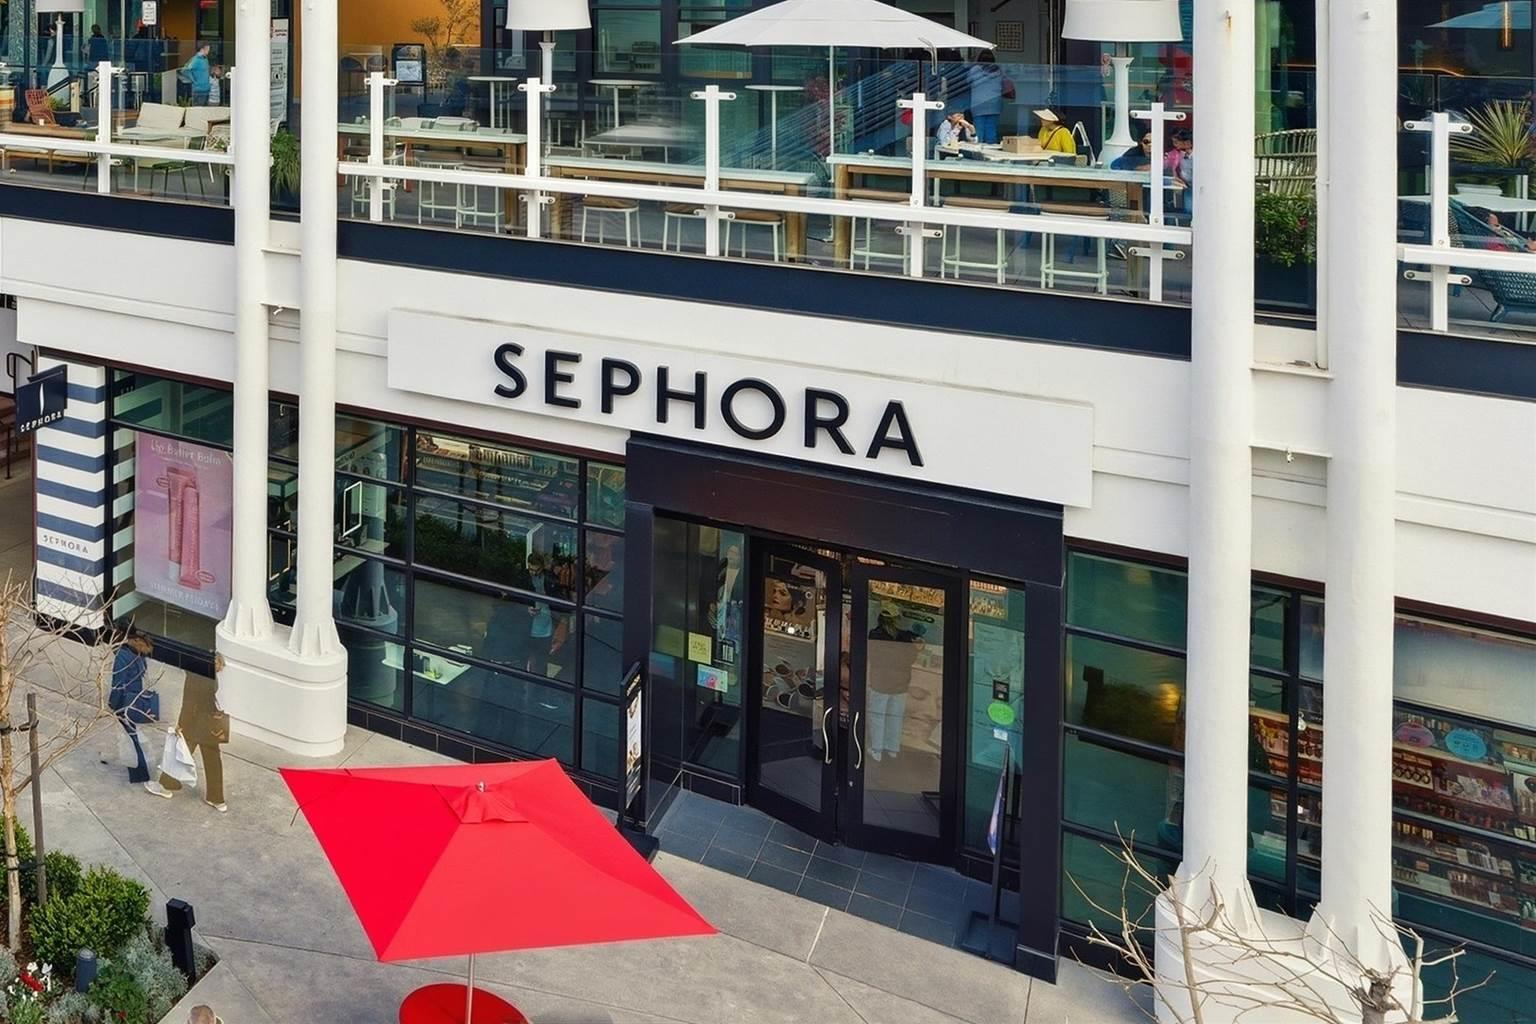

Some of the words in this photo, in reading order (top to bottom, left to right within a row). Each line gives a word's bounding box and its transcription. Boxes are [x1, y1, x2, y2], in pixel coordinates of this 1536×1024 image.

[493, 342, 925, 468] SEPHORA
[20, 410, 64, 433] SEPHORA
[43, 534, 88, 554] SEPHORA
